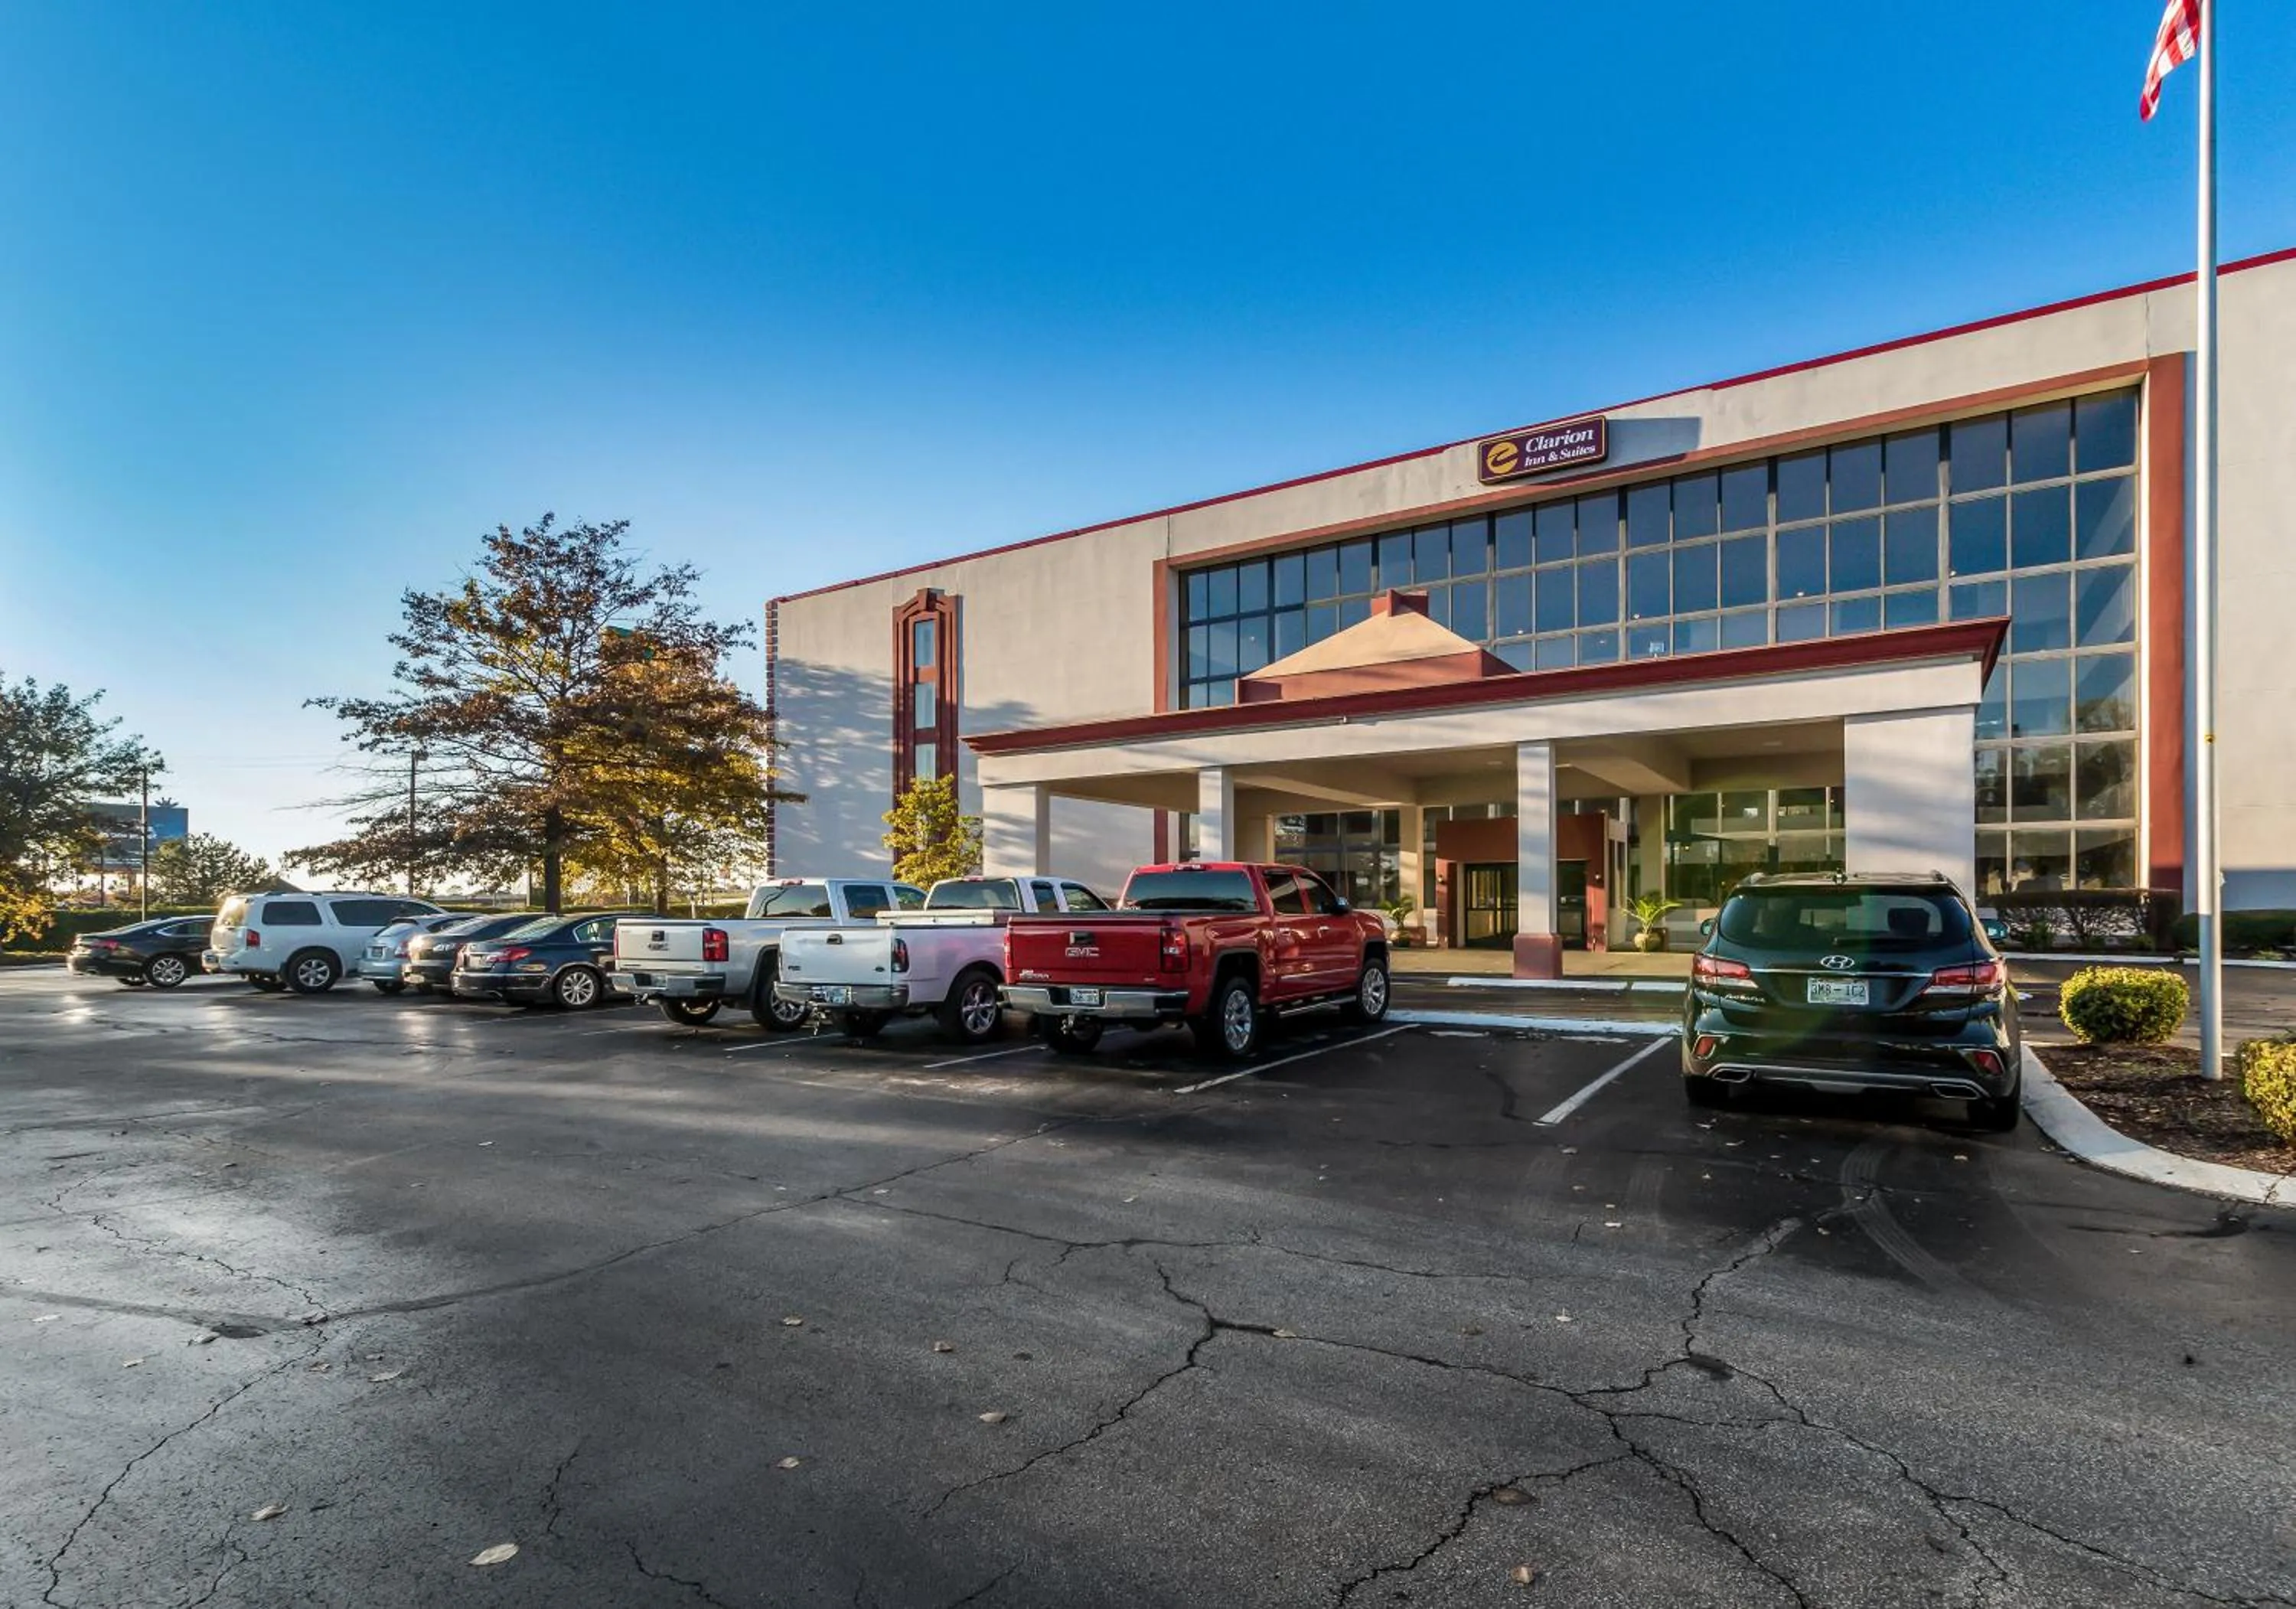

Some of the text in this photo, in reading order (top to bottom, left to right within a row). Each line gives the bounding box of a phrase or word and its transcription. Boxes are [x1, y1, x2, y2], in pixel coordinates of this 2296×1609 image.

[1525, 429, 1594, 452] Clarion
[1525, 445, 1596, 466] Inn & Suites
[1065, 947, 1100, 957] GMC
